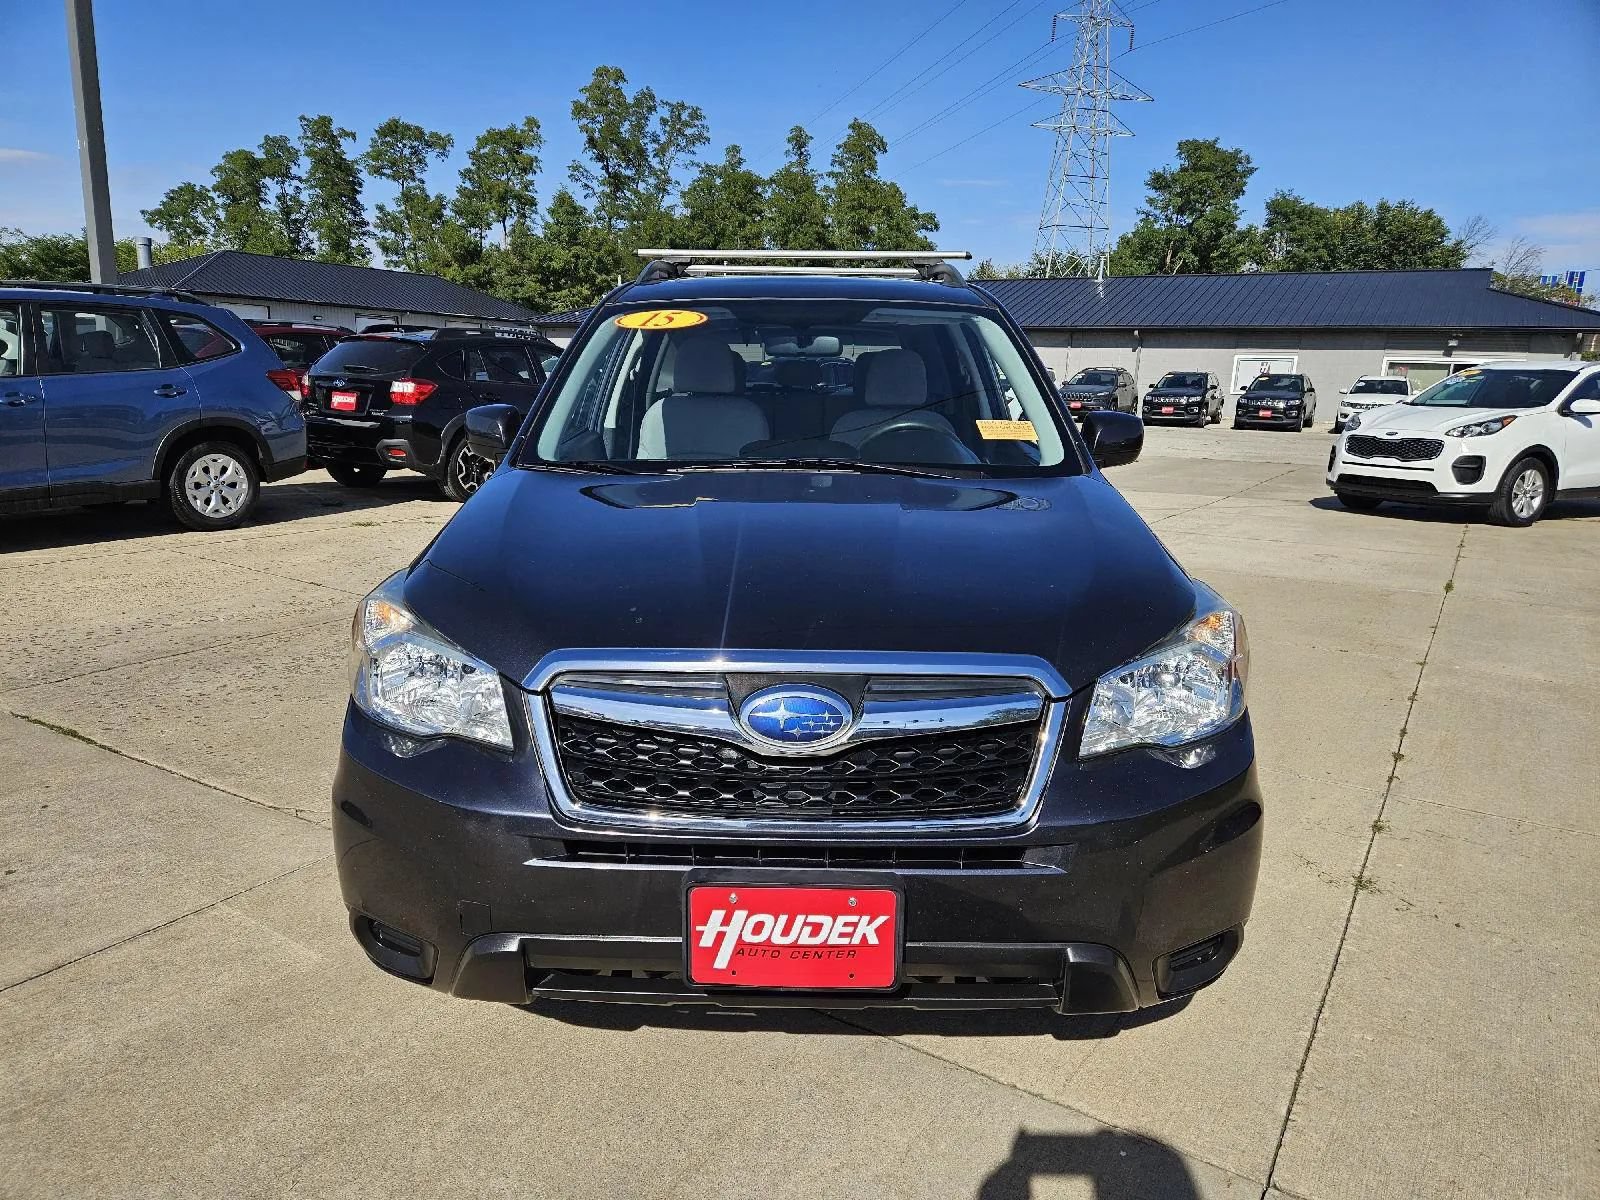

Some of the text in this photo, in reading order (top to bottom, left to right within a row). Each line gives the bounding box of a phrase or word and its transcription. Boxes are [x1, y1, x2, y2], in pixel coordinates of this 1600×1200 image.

[639, 312, 683, 326] 15
[696, 909, 890, 969] HOUDEK
[735, 947, 857, 960] AUTO CENTER
